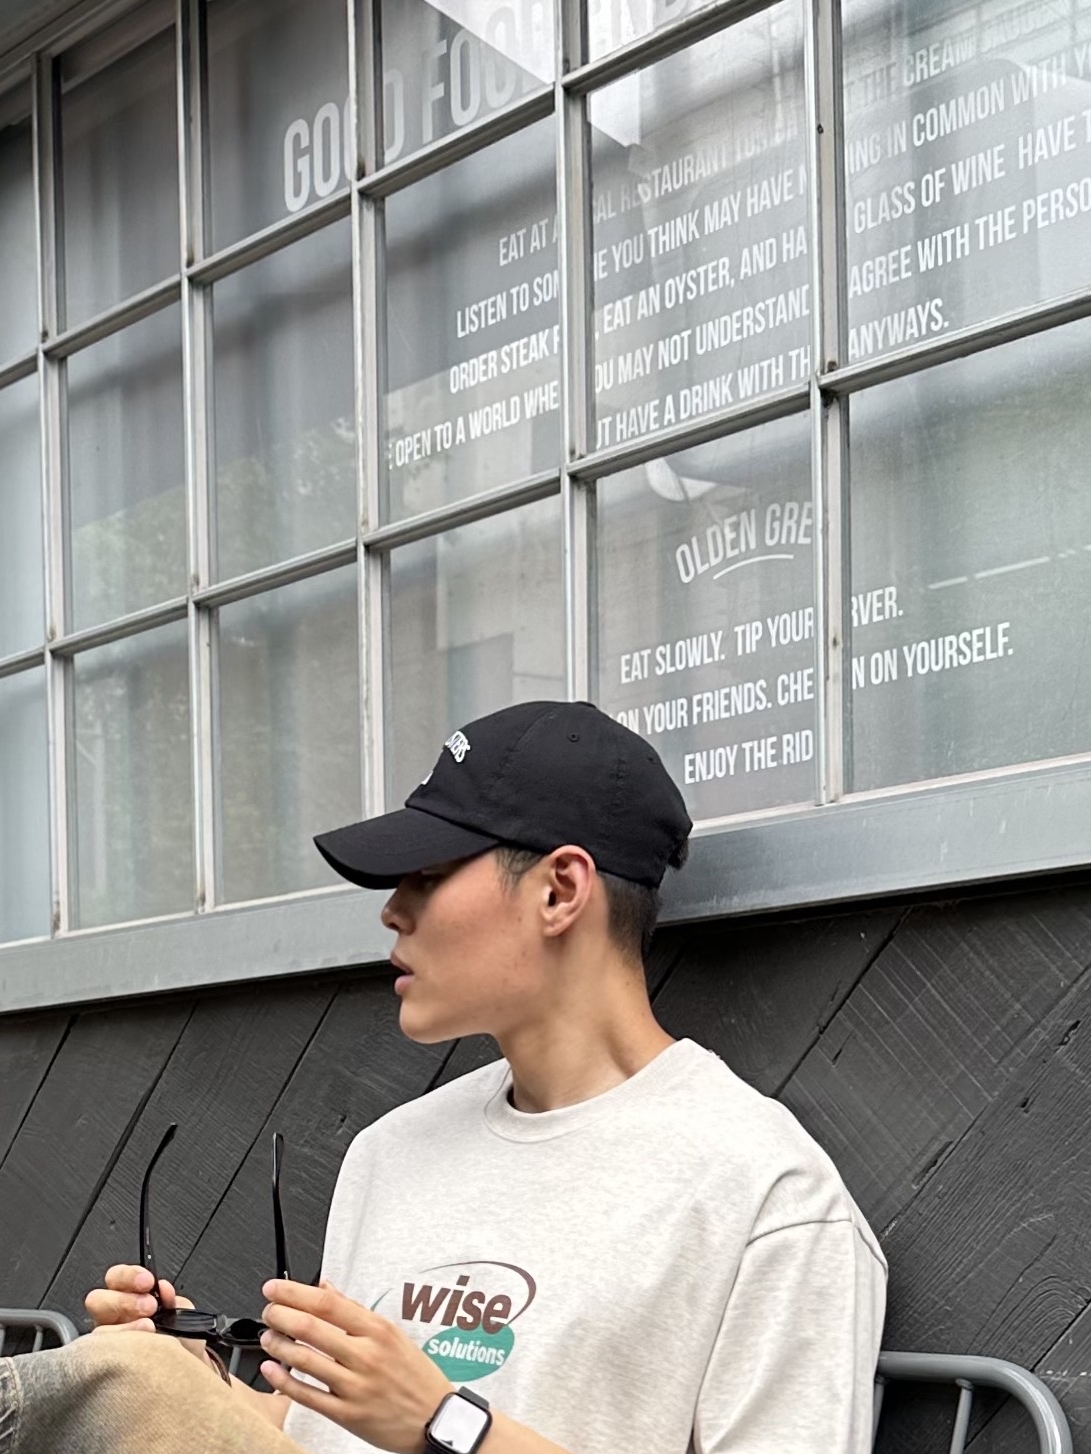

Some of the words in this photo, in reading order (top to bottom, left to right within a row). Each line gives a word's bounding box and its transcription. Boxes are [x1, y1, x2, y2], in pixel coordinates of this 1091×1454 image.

[457, 291, 507, 338] LISTEN
[510, 283, 529, 315] TO
[612, 233, 644, 274] YOU
[648, 210, 700, 258] THINK
[704, 192, 741, 236] MAY
[747, 169, 793, 217] HAVE
[887, 120, 907, 158] IN
[912, 78, 1005, 147] COMMON
[1011, 52, 1067, 106] WITH
[499, 228, 527, 267] EAT
[530, 218, 549, 254] AT
[903, 34, 977, 87] CREAM
[450, 350, 498, 394] ORDER
[501, 333, 550, 374] STEAK
[603, 295, 633, 334] EAT
[637, 283, 660, 320] AN
[665, 256, 735, 309] OYSTER,
[739, 237, 777, 280] AND
[782, 225, 808, 263] HA
[854, 181, 915, 234] GLASS
[921, 168, 946, 207] OF
[951, 144, 1006, 195] WINE
[1018, 115, 1076, 170] HAVE
[396, 428, 431, 467] OPEN
[434, 421, 452, 452] TO
[455, 416, 466, 445] A
[469, 396, 520, 440] WORLD
[524, 380, 559, 420] WHE
[595, 359, 614, 394] OU
[618, 344, 654, 385] MAY
[658, 329, 692, 370] NOT
[848, 244, 912, 298] AGREE
[917, 223, 970, 273] WITH
[974, 205, 1017, 250] THE
[1022, 177, 1091, 234] PERSO
[616, 399, 660, 442] HAVE
[664, 394, 676, 426] A
[679, 372, 734, 420] DRINK
[737, 354, 784, 400] WITH
[788, 345, 810, 385] TH
[848, 298, 949, 361] ANYWAYS.
[675, 508, 757, 584] OLDEN
[764, 501, 813, 546] GRE
[621, 649, 652, 684] EAT
[655, 630, 725, 676] SLOWLY.
[734, 620, 763, 656] TIP
[766, 607, 814, 648] YOUR
[643, 698, 688, 735] YOUR
[692, 679, 772, 725] FRIENDS.
[777, 668, 814, 706] CHE
[870, 648, 898, 686] ON
[902, 622, 1014, 678] YOURSELF.
[684, 744, 738, 785] ENJOY
[742, 736, 778, 773] THE
[782, 729, 814, 765] RID
[402, 1275, 512, 1334] wise
[428, 1337, 506, 1366] solutions
